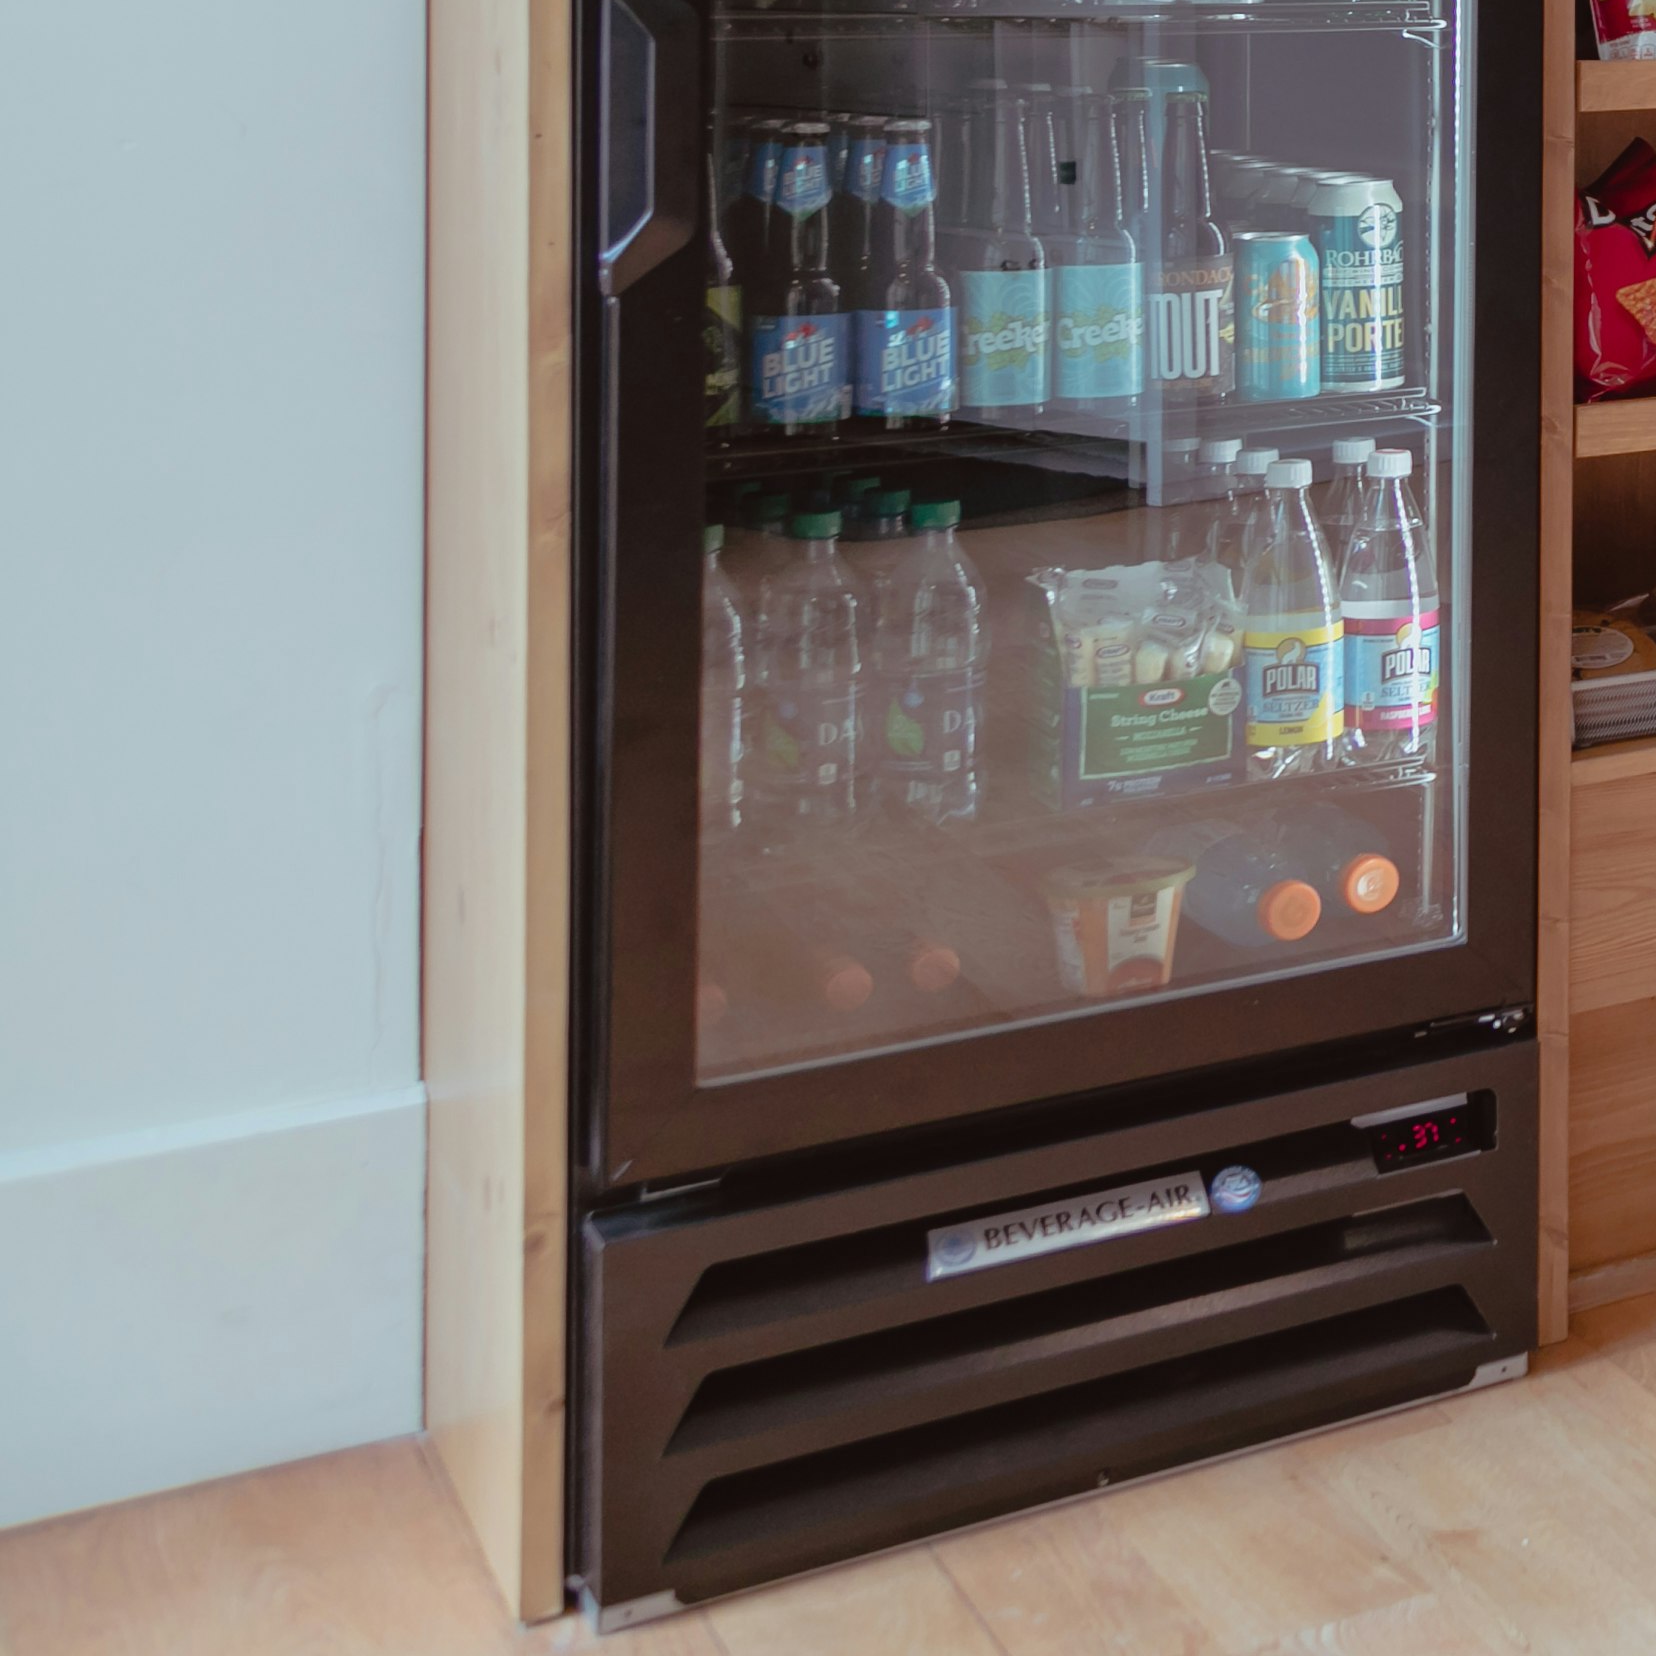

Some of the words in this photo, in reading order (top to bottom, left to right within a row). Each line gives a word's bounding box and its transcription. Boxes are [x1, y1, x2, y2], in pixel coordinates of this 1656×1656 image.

[782, 163, 822, 181] BLUE
[1322, 286, 1404, 320] VANILL
[1148, 289, 1223, 380] TOUT
[1327, 318, 1404, 354] PORTE
[763, 337, 835, 378] BLUE
[881, 329, 951, 375] BLUE
[761, 362, 835, 399] LIGHT
[881, 354, 950, 393] LIGHT
[1265, 665, 1318, 694] POLAR
[1385, 648, 1431, 679] POLAR
[1146, 689, 1178, 703] Kraft
[1262, 699, 1319, 713] SELTZER
[1380, 684, 1431, 699] SELTE
[1111, 714, 1156, 728] String
[1158, 706, 1209, 723] Cheese
[1413, 1121, 1440, 1149] 37
[982, 1183, 1193, 1252] BEVERAGE-AIR
